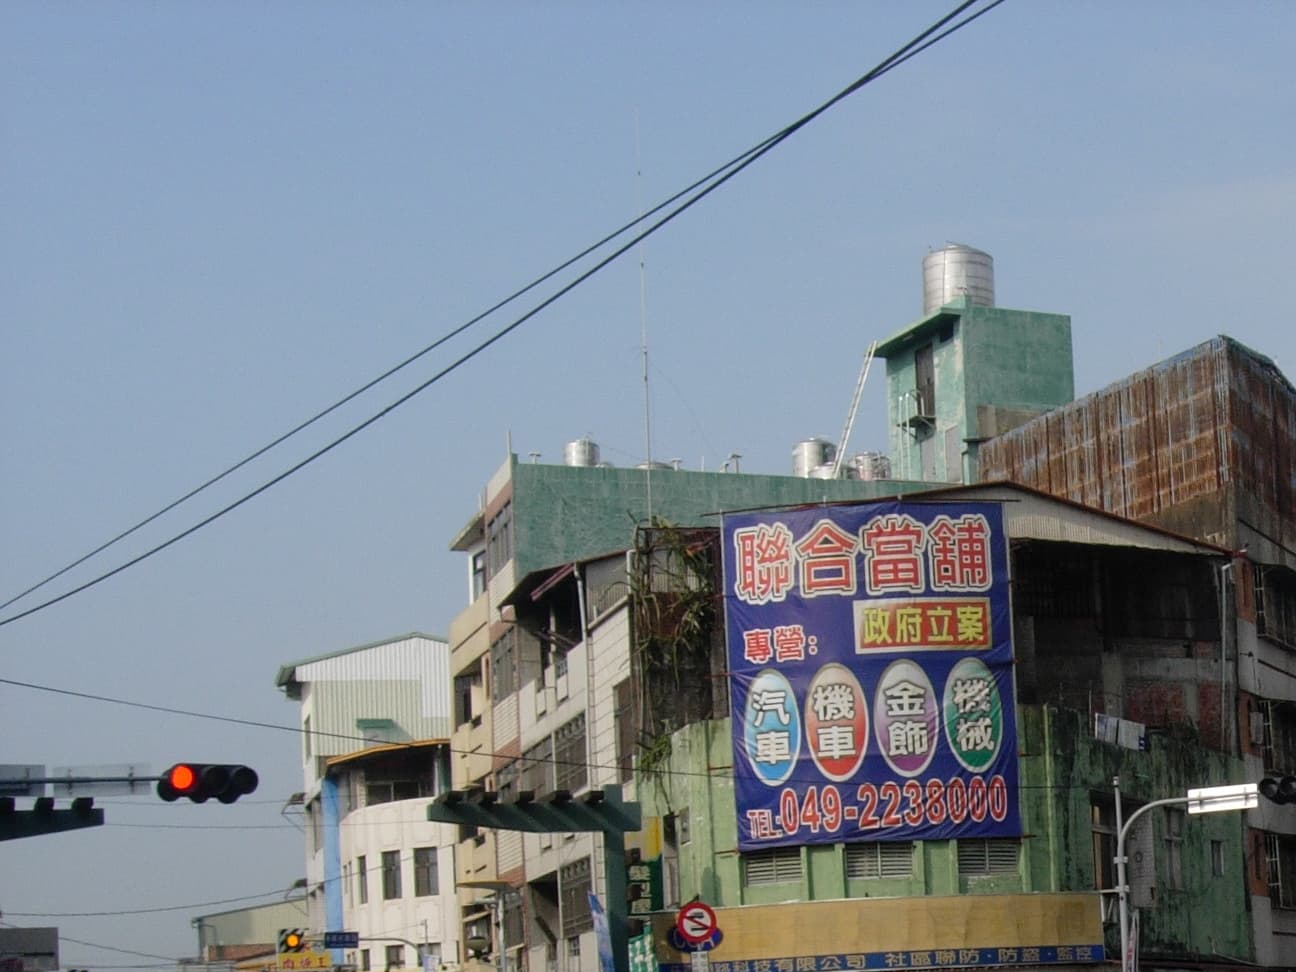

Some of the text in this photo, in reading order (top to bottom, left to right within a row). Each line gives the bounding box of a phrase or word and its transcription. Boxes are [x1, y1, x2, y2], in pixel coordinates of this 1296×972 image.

[862, 605, 985, 644] 政府立案
[751, 690, 791, 764] 汽車
[813, 683, 856, 760] 機車
[884, 680, 928, 756] 金飾
[952, 679, 995, 751] 機械
